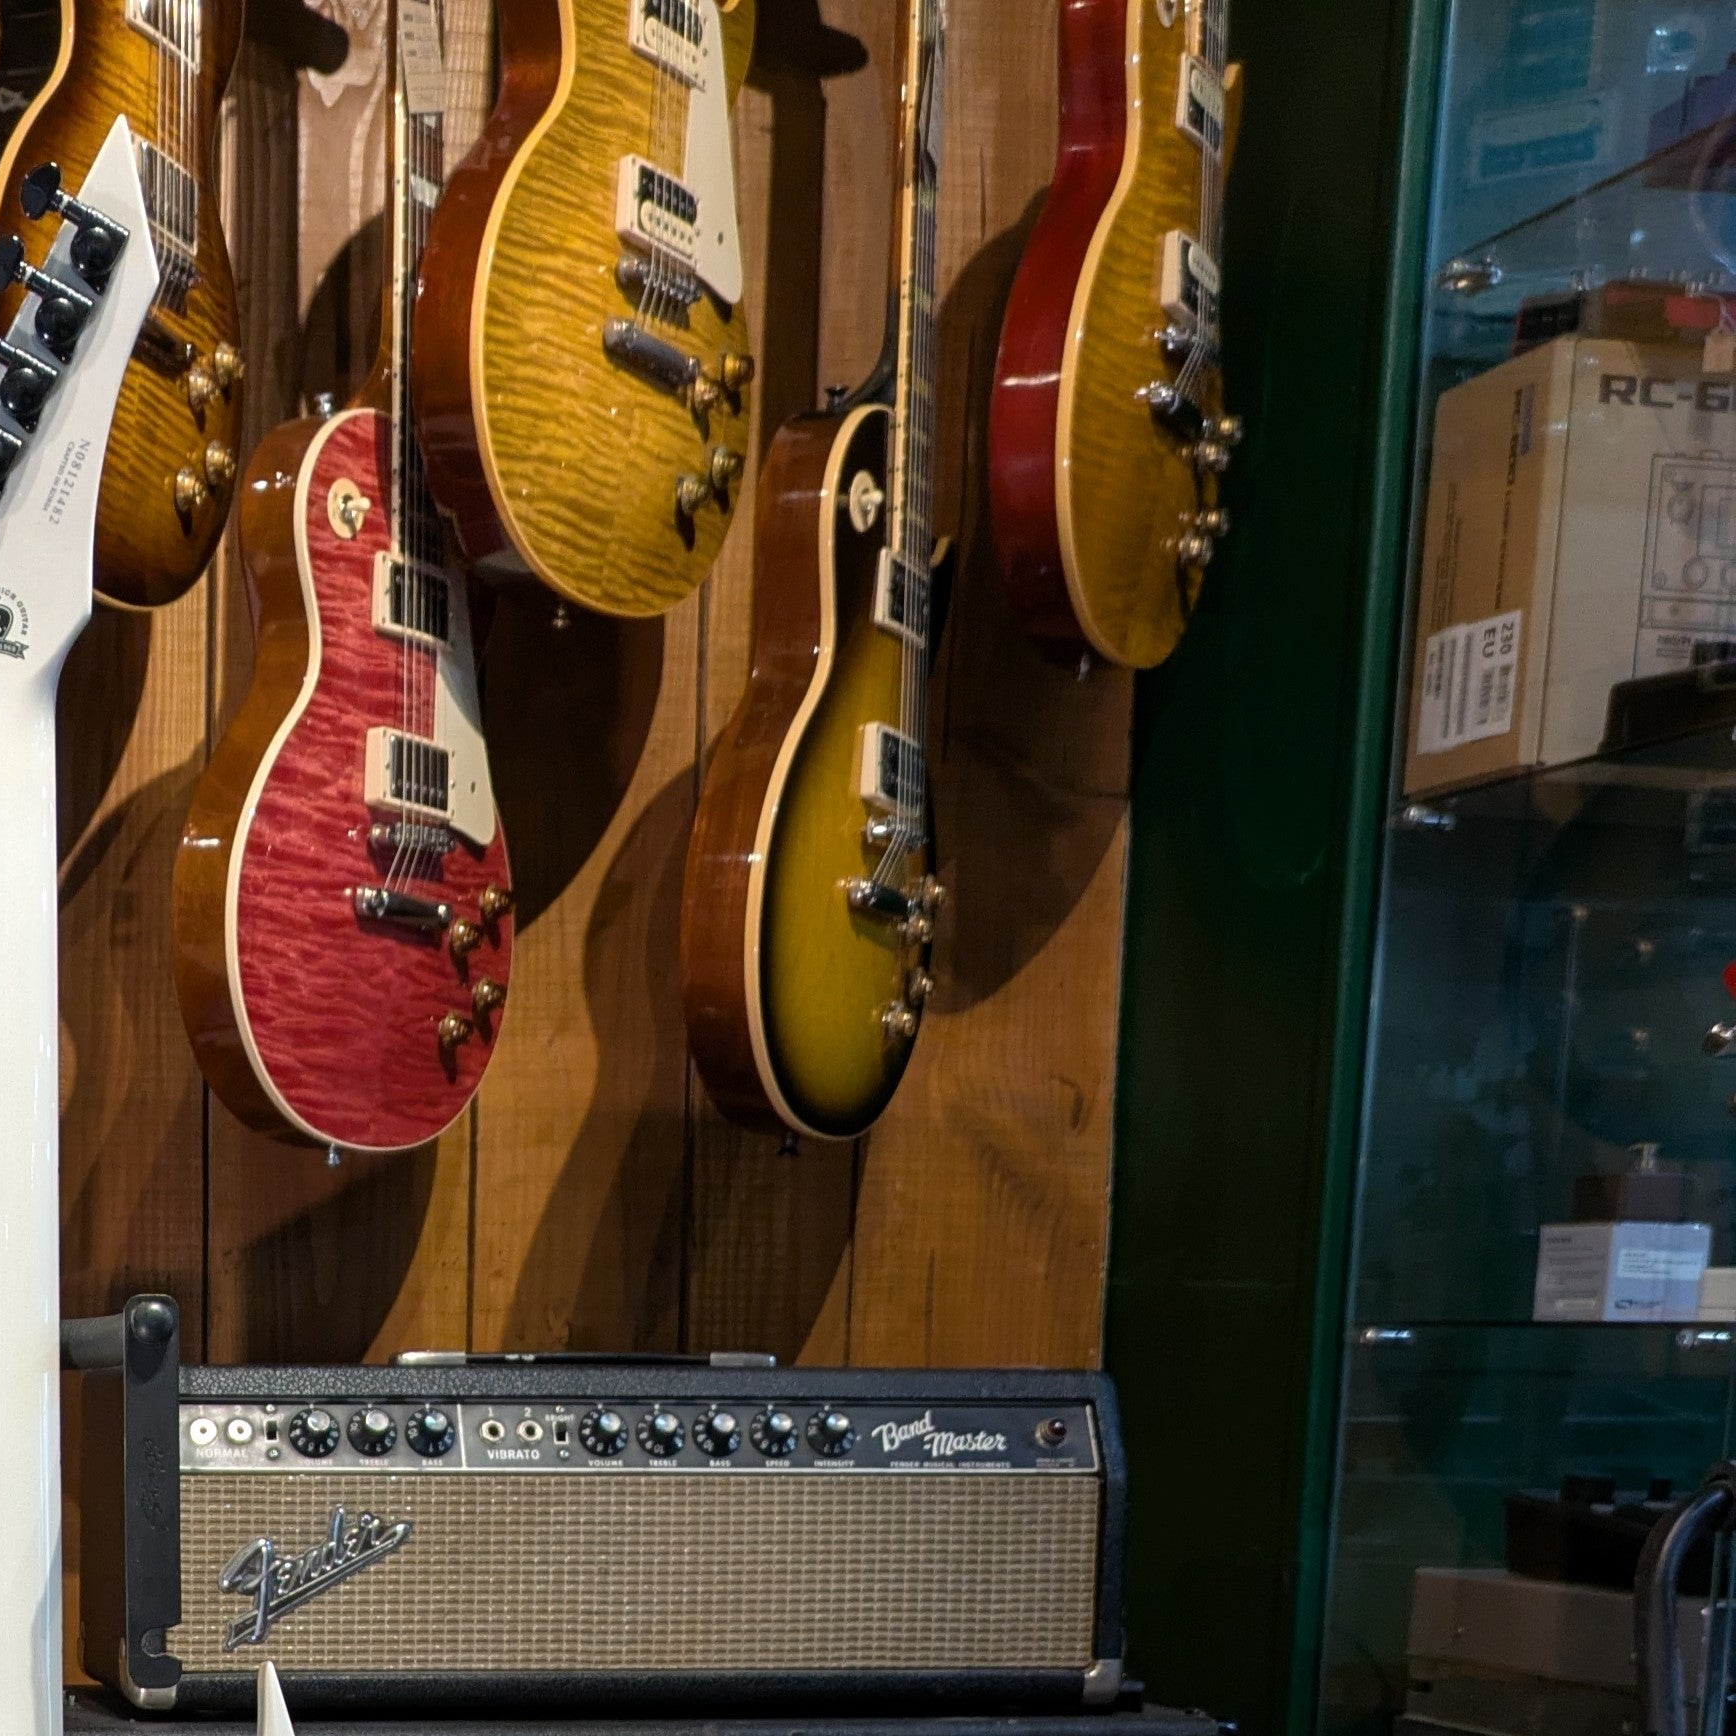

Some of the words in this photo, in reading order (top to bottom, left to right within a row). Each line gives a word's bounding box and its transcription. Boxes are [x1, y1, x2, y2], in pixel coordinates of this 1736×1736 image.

[1599, 374, 1736, 413] RC-6
[524, 1407, 532, 1418] 2
[871, 1409, 935, 1452] Band
[195, 1448, 249, 1458] NORMAL
[922, 1430, 1007, 1457] Master
[486, 1449, 540, 1460] VIBRATO
[588, 1459, 623, 1467] VOLUME
[218, 1503, 412, 1650] Fender
